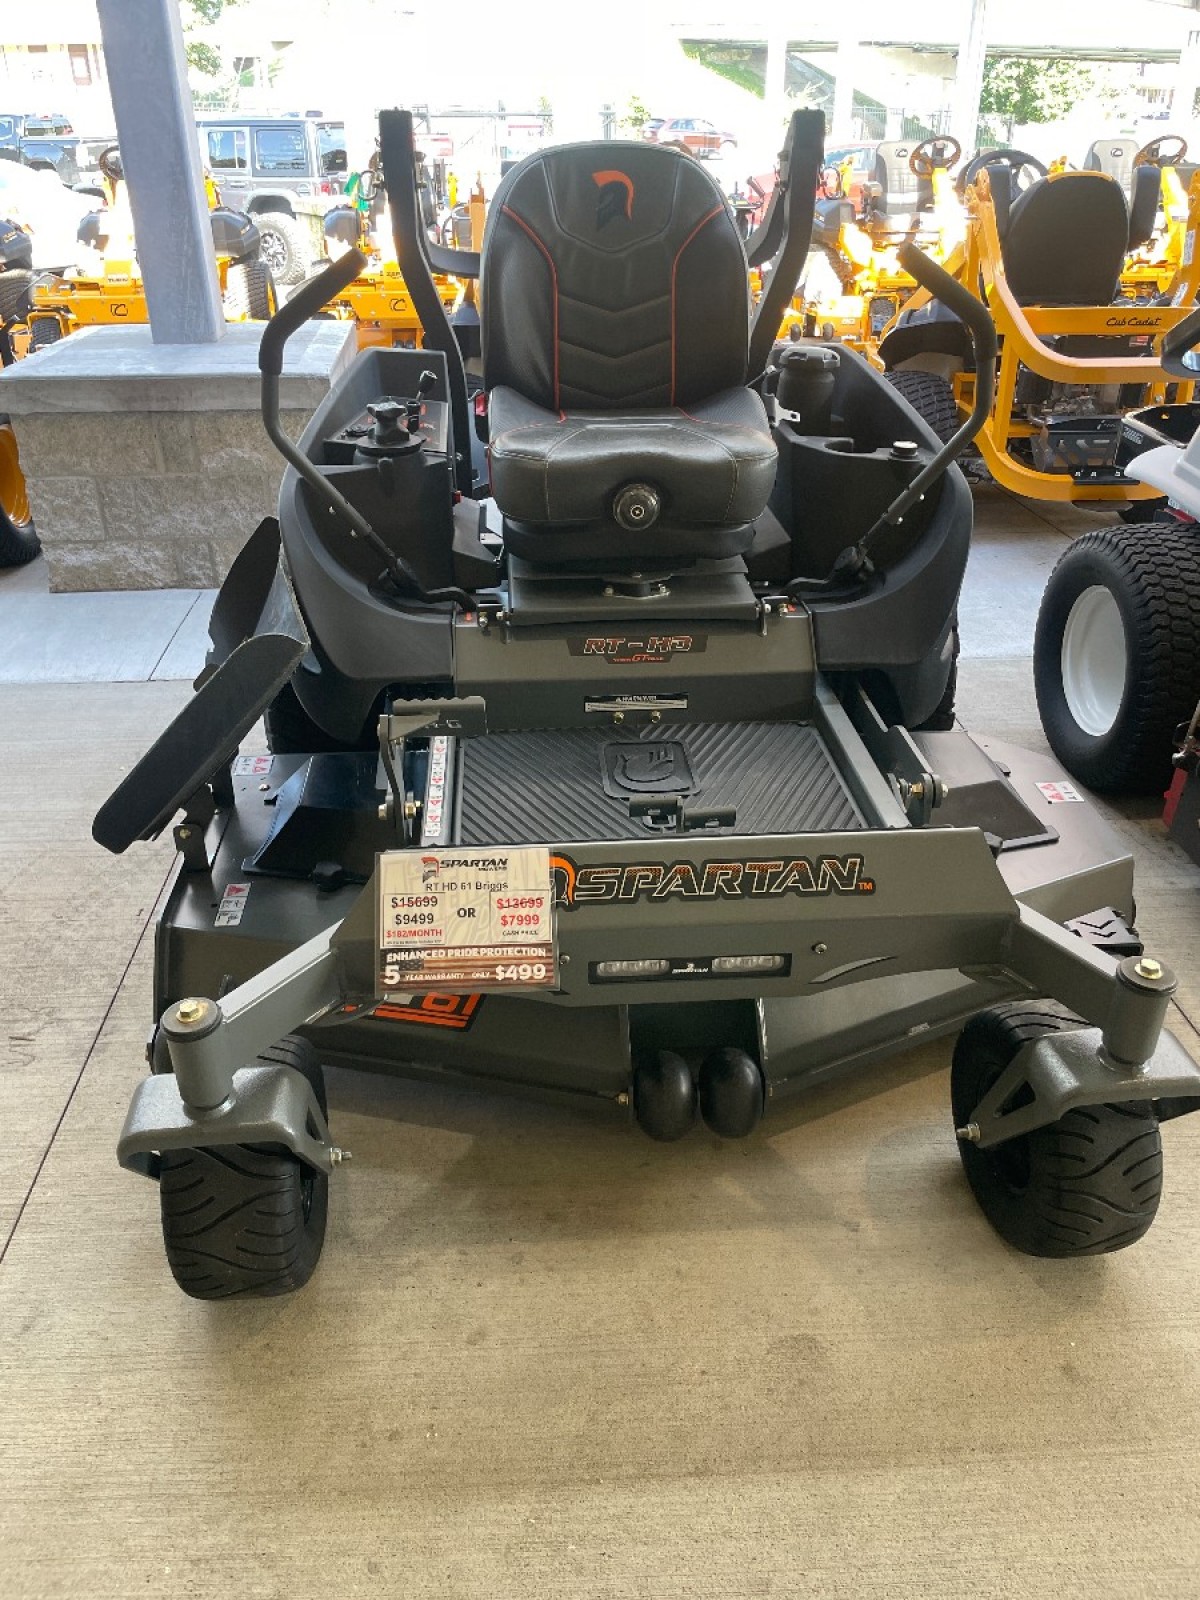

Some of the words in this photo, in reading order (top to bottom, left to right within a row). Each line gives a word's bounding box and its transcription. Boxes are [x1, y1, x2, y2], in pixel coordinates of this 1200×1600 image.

[1106, 317, 1126, 326] Cub
[1128, 317, 1162, 326] Cadet
[440, 858, 508, 868] SPARTAN
[575, 858, 860, 900] SPARTAN
[426, 883, 439, 891] RT
[442, 882, 458, 891] HD
[461, 882, 472, 890] 61
[475, 880, 509, 892] Briggs
[456, 907, 476, 918] OR
[395, 913, 434, 925] $9499
[500, 914, 540, 927] $7999
[386, 929, 442, 938] $182/MONTH
[386, 949, 446, 963] ENHANCED
[447, 948, 479, 958] PRIDE
[479, 947, 546, 957] PROTECTION
[383, 965, 400, 985] 5
[425, 972, 465, 980] WARRANTY
[471, 971, 490, 979] ONLY
[495, 963, 546, 981] $499
